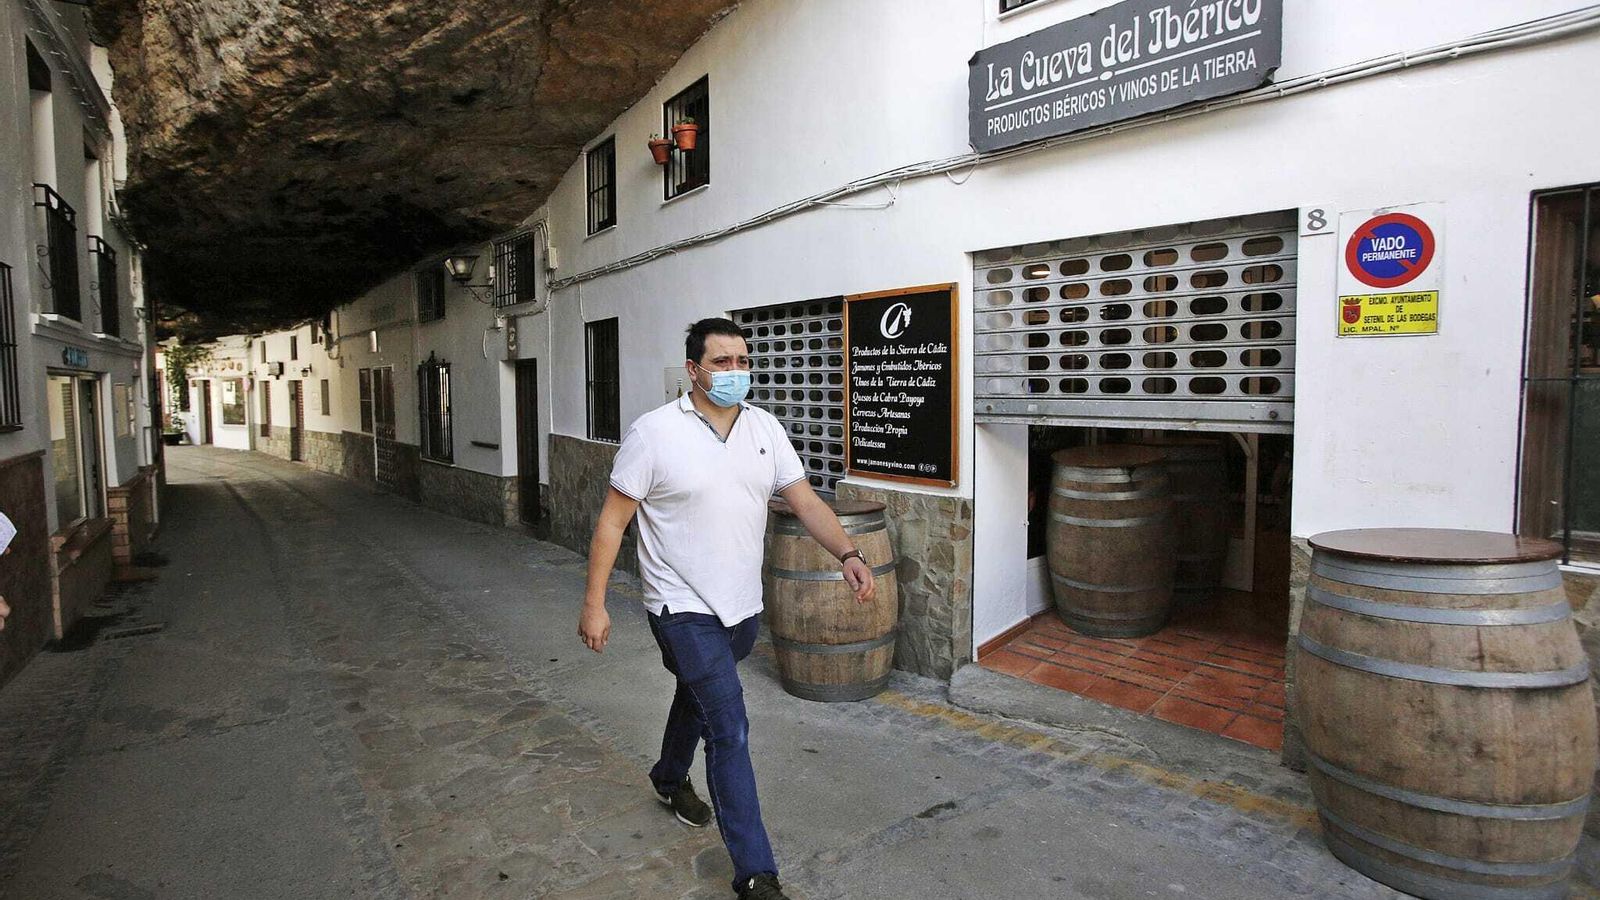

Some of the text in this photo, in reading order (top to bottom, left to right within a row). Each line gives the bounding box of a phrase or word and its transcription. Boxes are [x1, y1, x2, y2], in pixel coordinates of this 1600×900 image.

[986, 0, 1262, 102] La Cueva del Ibérico
[987, 48, 1257, 136] PRODUCTOS IBÉRICOS Y VINOS DE LA TIERRA
[1307, 208, 1328, 231] 8
[1371, 235, 1406, 252] VADO
[1362, 248, 1417, 262] PERMANENTE
[1390, 294, 1432, 304] AYUNTAMIENTO
[1395, 305, 1403, 313] DE
[1364, 313, 1436, 324] SETENIL DE LAS BODEGAS
[852, 346, 881, 356] Productos
[882, 345, 888, 355] de
[889, 344, 895, 355] la
[896, 344, 917, 354] Sierra
[919, 343, 926, 354] de
[852, 361, 875, 374] Jamones
[876, 364, 880, 374] y
[881, 360, 912, 371] Embutidos
[870, 376, 877, 386] de
[878, 376, 883, 386] la
[886, 376, 907, 387] Tierra
[908, 376, 915, 386] de
[852, 391, 925, 407] Quesos de Cabra Payoya
[852, 407, 911, 419] Cervezas Artesanas
[884, 423, 908, 438] Propia
[856, 458, 916, 470] www.jamonesyvino.com
